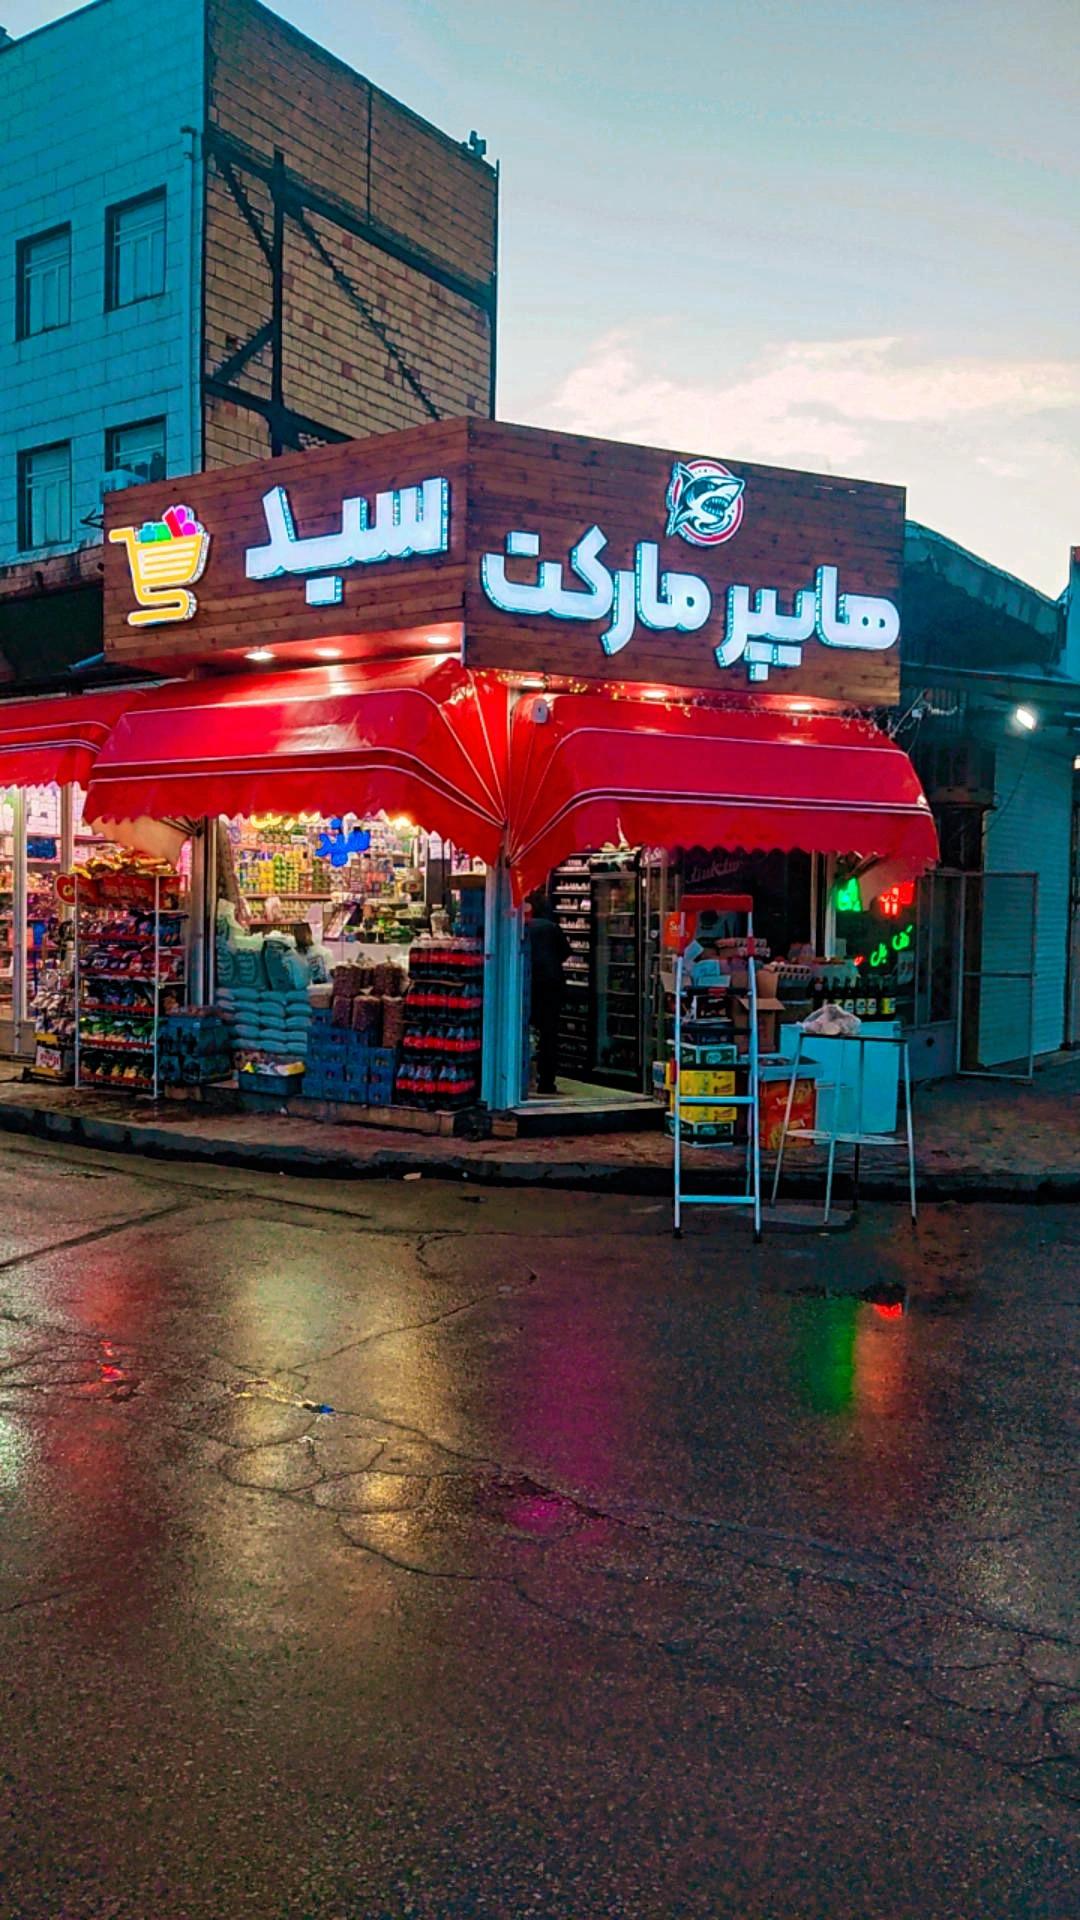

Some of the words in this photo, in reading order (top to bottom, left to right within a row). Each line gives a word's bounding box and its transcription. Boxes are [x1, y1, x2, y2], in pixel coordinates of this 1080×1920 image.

[245, 477, 449, 606] سبد
[481, 526, 712, 655] مارکت
[714, 566, 901, 682] هایپر
